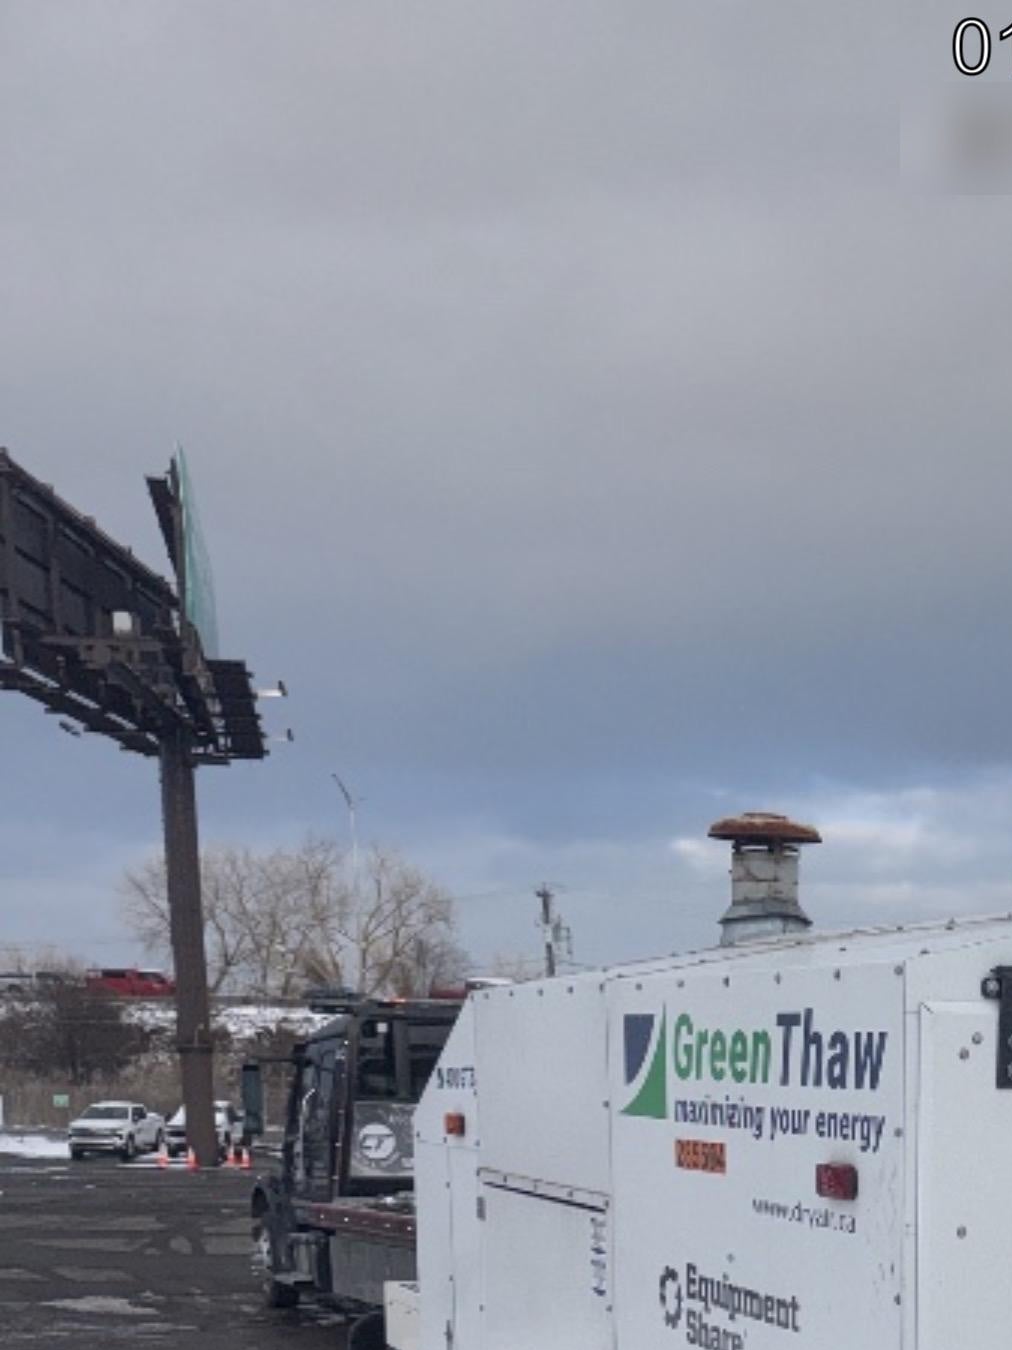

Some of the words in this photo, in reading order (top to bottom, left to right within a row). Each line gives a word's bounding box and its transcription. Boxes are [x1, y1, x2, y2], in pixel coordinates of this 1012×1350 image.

[674, 1094, 764, 1140] maximizing
[770, 1106, 810, 1140] your
[815, 1111, 885, 1153] energy
[686, 1262, 800, 1333] Equipment
